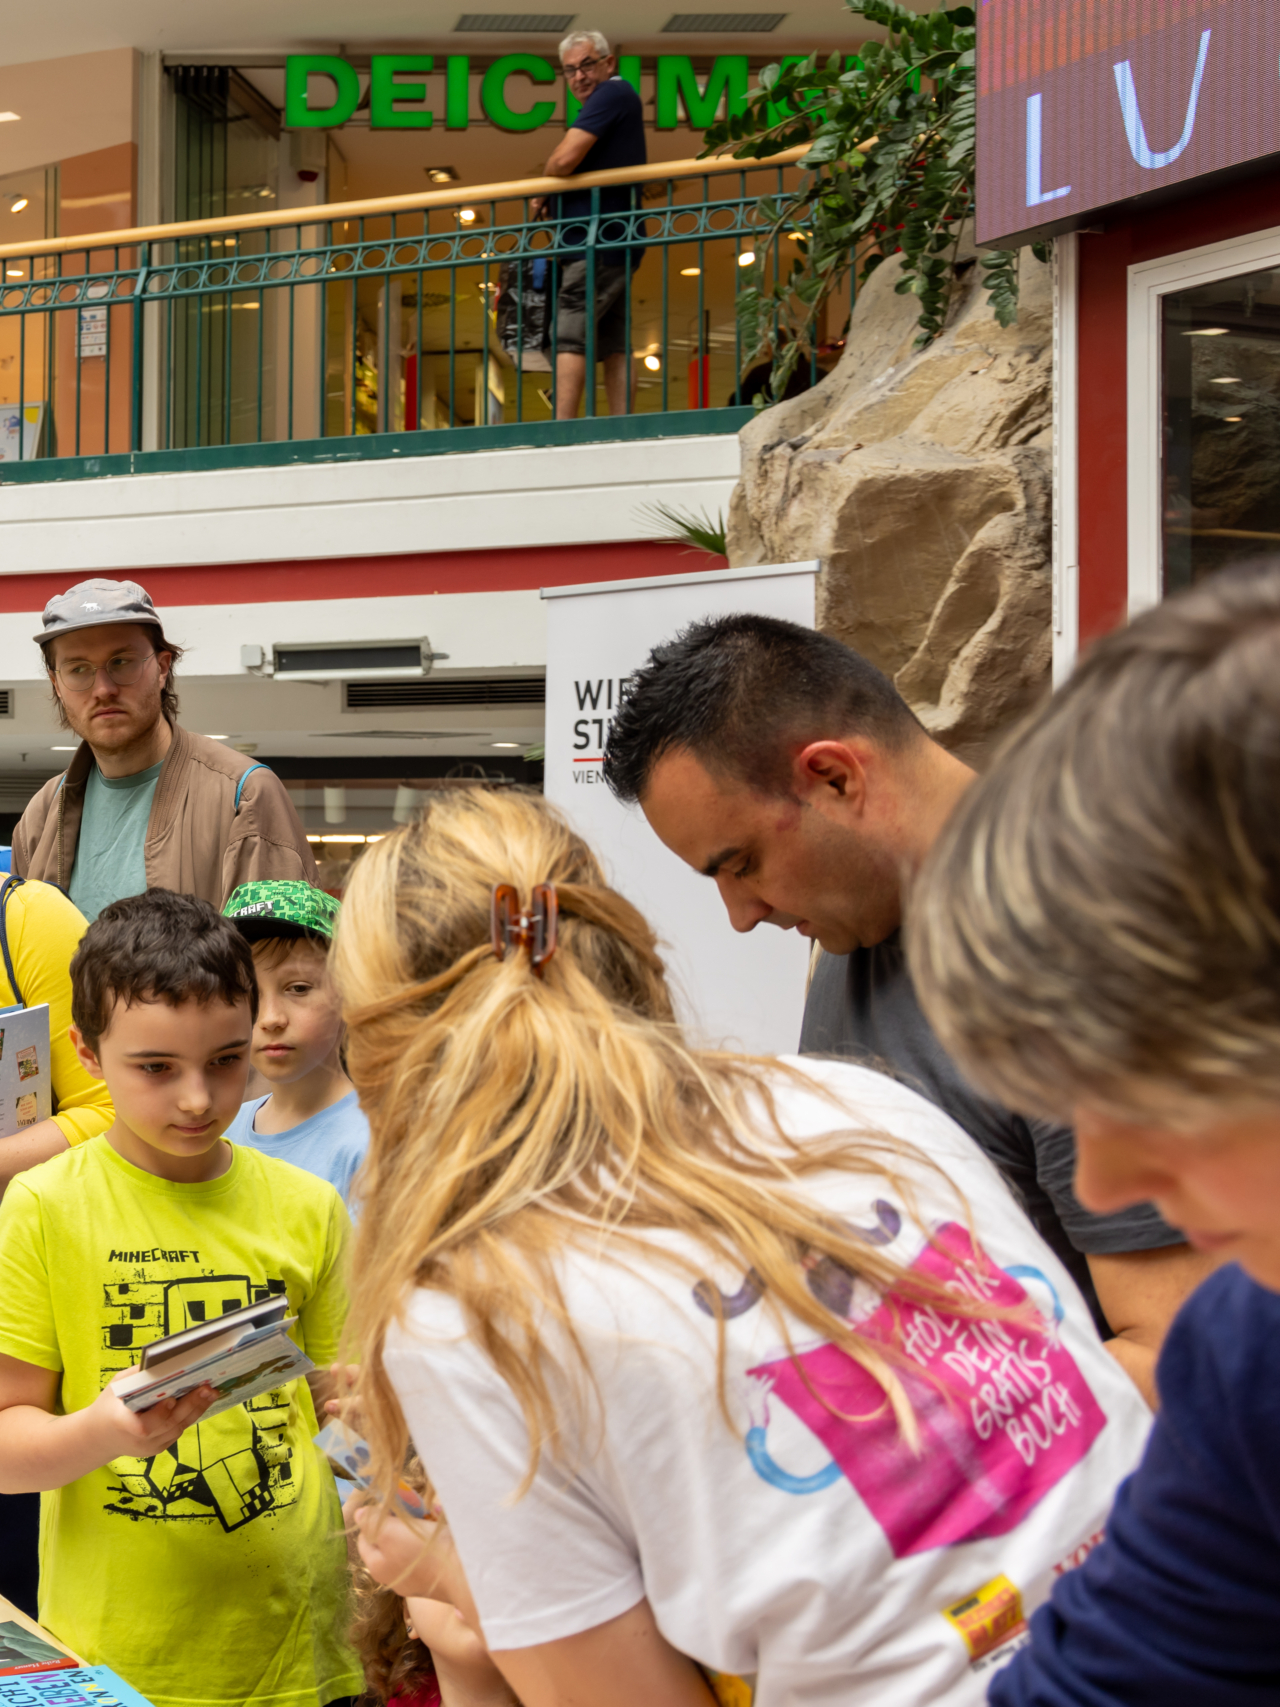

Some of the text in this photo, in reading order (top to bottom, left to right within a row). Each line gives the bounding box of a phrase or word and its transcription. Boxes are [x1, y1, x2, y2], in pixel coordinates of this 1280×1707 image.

[108, 1248, 200, 1263] MINECRAFT
[943, 1309, 1014, 1387] DEIN
[1004, 1382, 1083, 1466] BUCH
